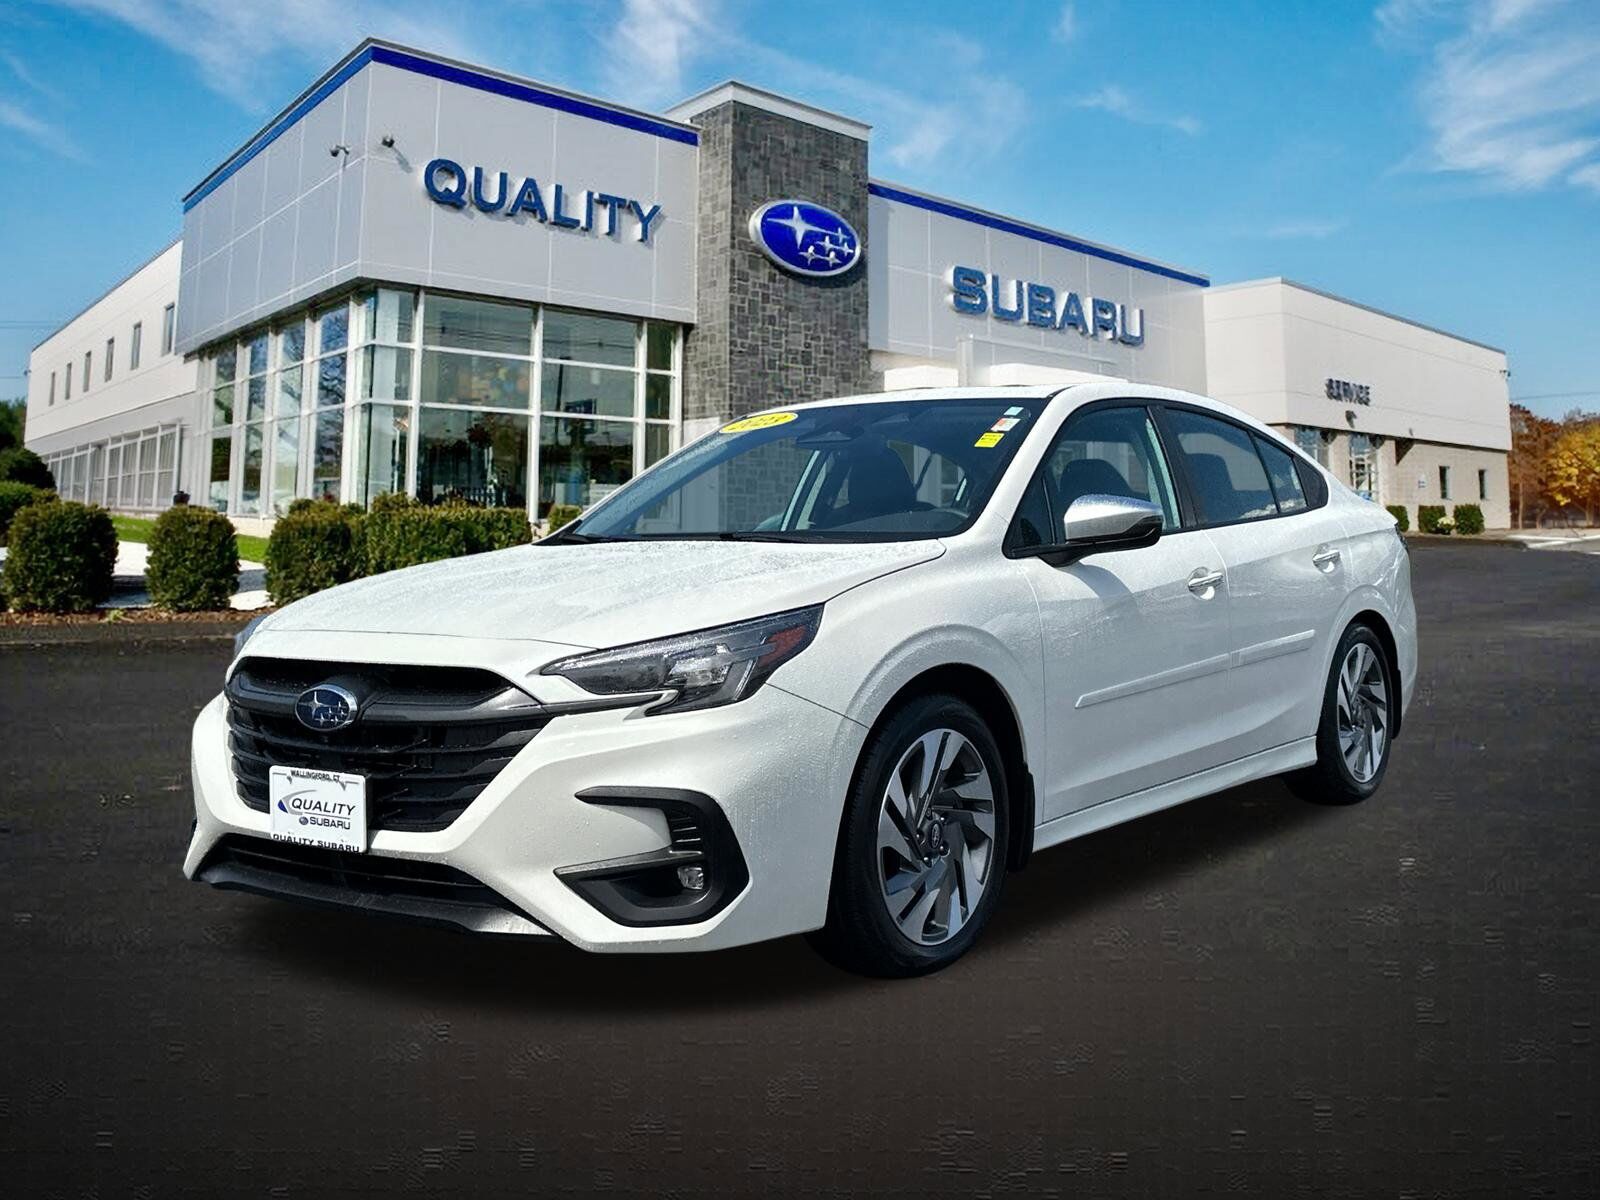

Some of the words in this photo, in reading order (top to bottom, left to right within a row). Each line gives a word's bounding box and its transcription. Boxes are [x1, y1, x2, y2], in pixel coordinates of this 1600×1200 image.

[423, 158, 662, 242] QUALITY
[949, 265, 1145, 346] SUBARU
[1325, 378, 1370, 406] SERVICE
[291, 797, 356, 816] QUALITY
[309, 816, 351, 830] SUBARU
[272, 833, 314, 846] QUALITY
[317, 840, 360, 853] SUBARU
